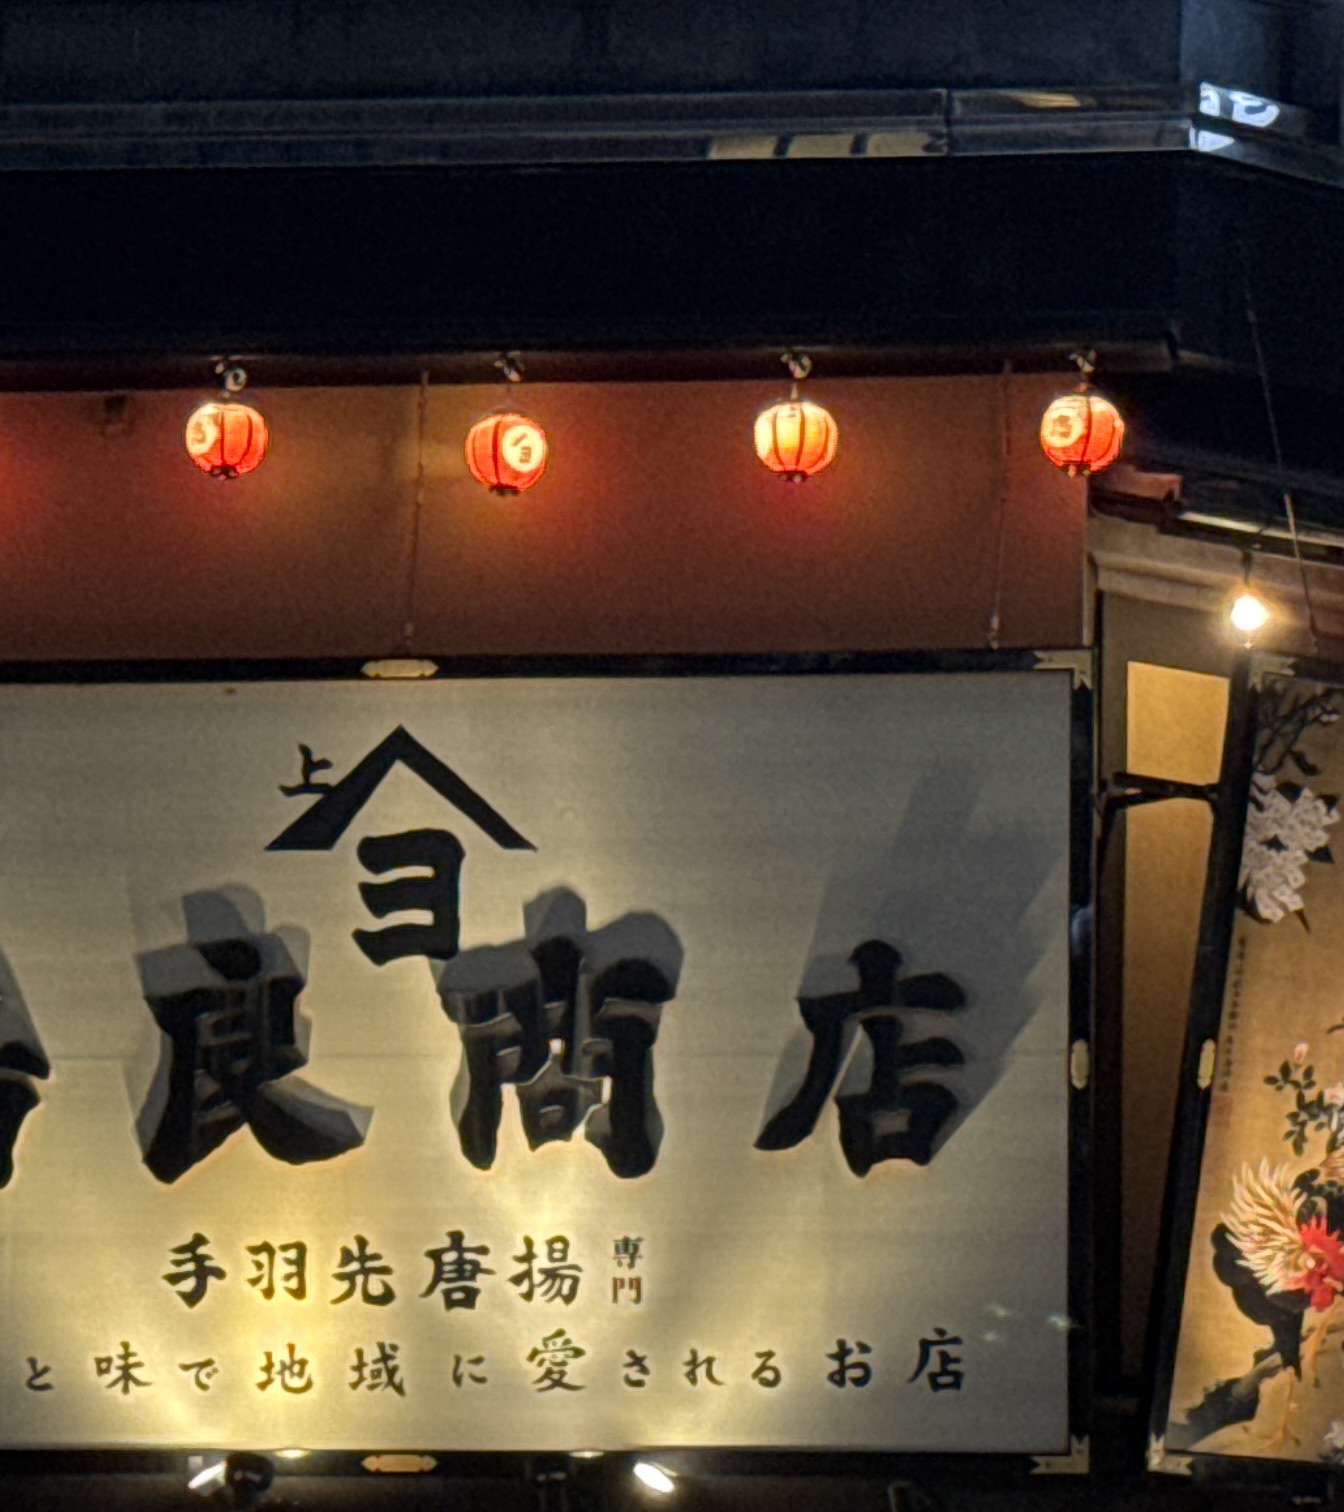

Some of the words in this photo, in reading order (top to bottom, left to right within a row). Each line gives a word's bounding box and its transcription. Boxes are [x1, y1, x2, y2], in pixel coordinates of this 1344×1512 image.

[160, 1230, 586, 1312] 手羽先唐揚
[610, 1233, 646, 1308] 専門
